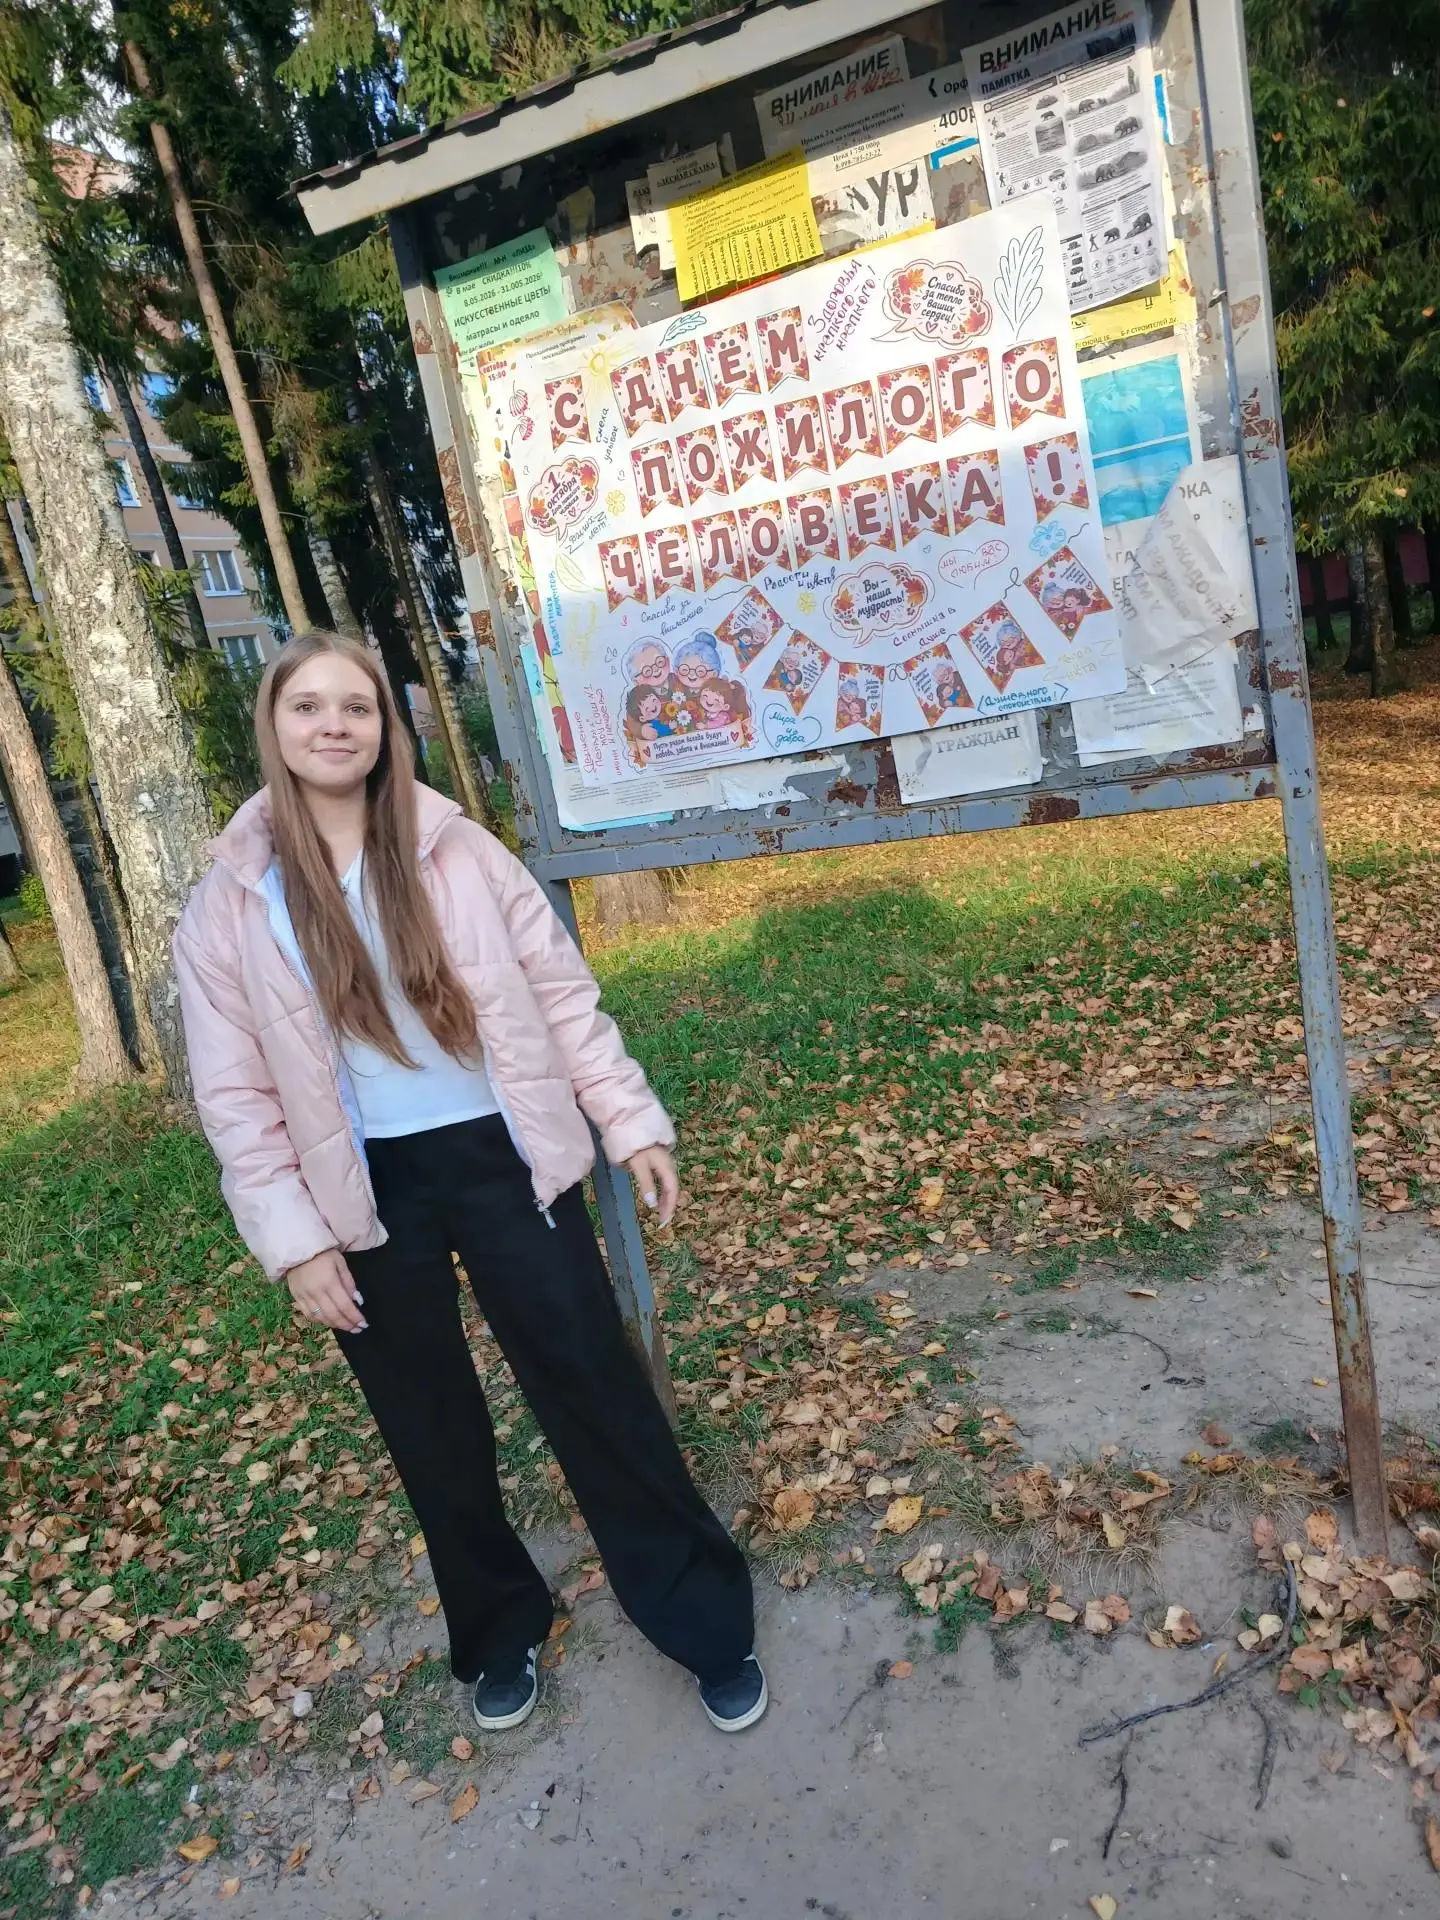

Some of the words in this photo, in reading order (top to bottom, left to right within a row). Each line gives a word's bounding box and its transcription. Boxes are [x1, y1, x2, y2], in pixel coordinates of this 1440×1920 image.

[979, 0, 1115, 73] ВНИМАНИЕ
[771, 48, 891, 118] ВНИМАНИЕ
[981, 67, 1031, 95] ПАМЯТКА
[462, 281, 476, 293] мае
[807, 259, 863, 334] Здоровья
[922, 288, 936, 302] за
[935, 292, 964, 306] тепло
[927, 275, 966, 297] Спасибо
[453, 295, 524, 328] ИСКУССТВЕННЫЕ
[524, 284, 551, 304] ЦВЕТЫ
[921, 308, 956, 324] сердец!
[926, 299, 955, 313] ваших
[465, 322, 501, 342] матрасы
[509, 310, 540, 327] одеяло
[554, 392, 581, 429] С
[625, 323, 802, 416] ДНЁМ
[641, 358, 1051, 498] ПОЖИЛОГО
[546, 477, 578, 510] октября
[548, 472, 561, 494] 1
[609, 467, 996, 588] ЧЕЛОВЕКА
[862, 577, 880, 593] Вы
[865, 587, 892, 604] наша
[641, 597, 677, 624] Спасибо
[856, 590, 906, 619] мудрость!
[705, 730, 723, 744] будут
[936, 725, 1020, 754] ГРАЖДАН
